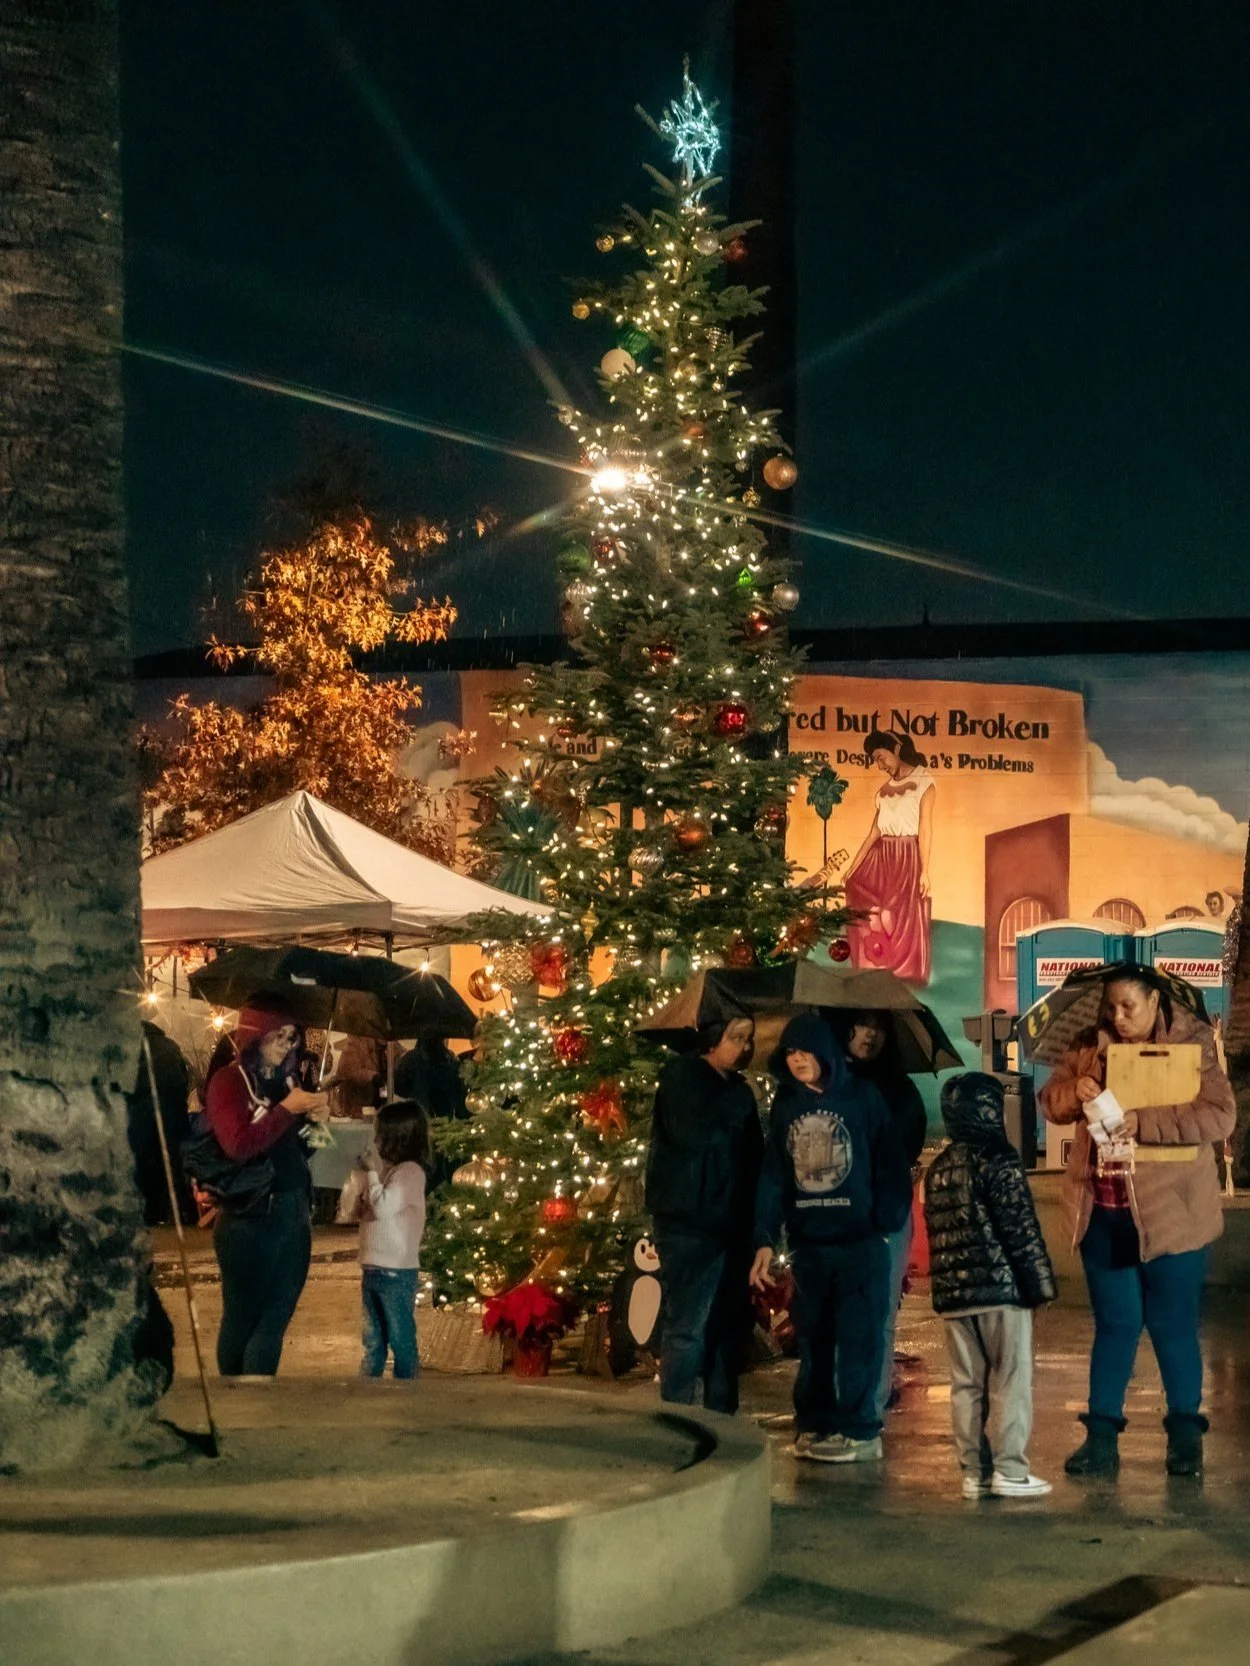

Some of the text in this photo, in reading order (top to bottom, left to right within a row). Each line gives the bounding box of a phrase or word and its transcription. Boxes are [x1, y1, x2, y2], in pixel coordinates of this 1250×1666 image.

[787, 705, 1050, 741] red but Not Broken
[566, 738, 597, 754] and
[836, 748, 874, 769] Desp
[929, 752, 953, 768] a's
[958, 753, 1035, 773] Problems
[1159, 962, 1221, 972] NATIONAL
